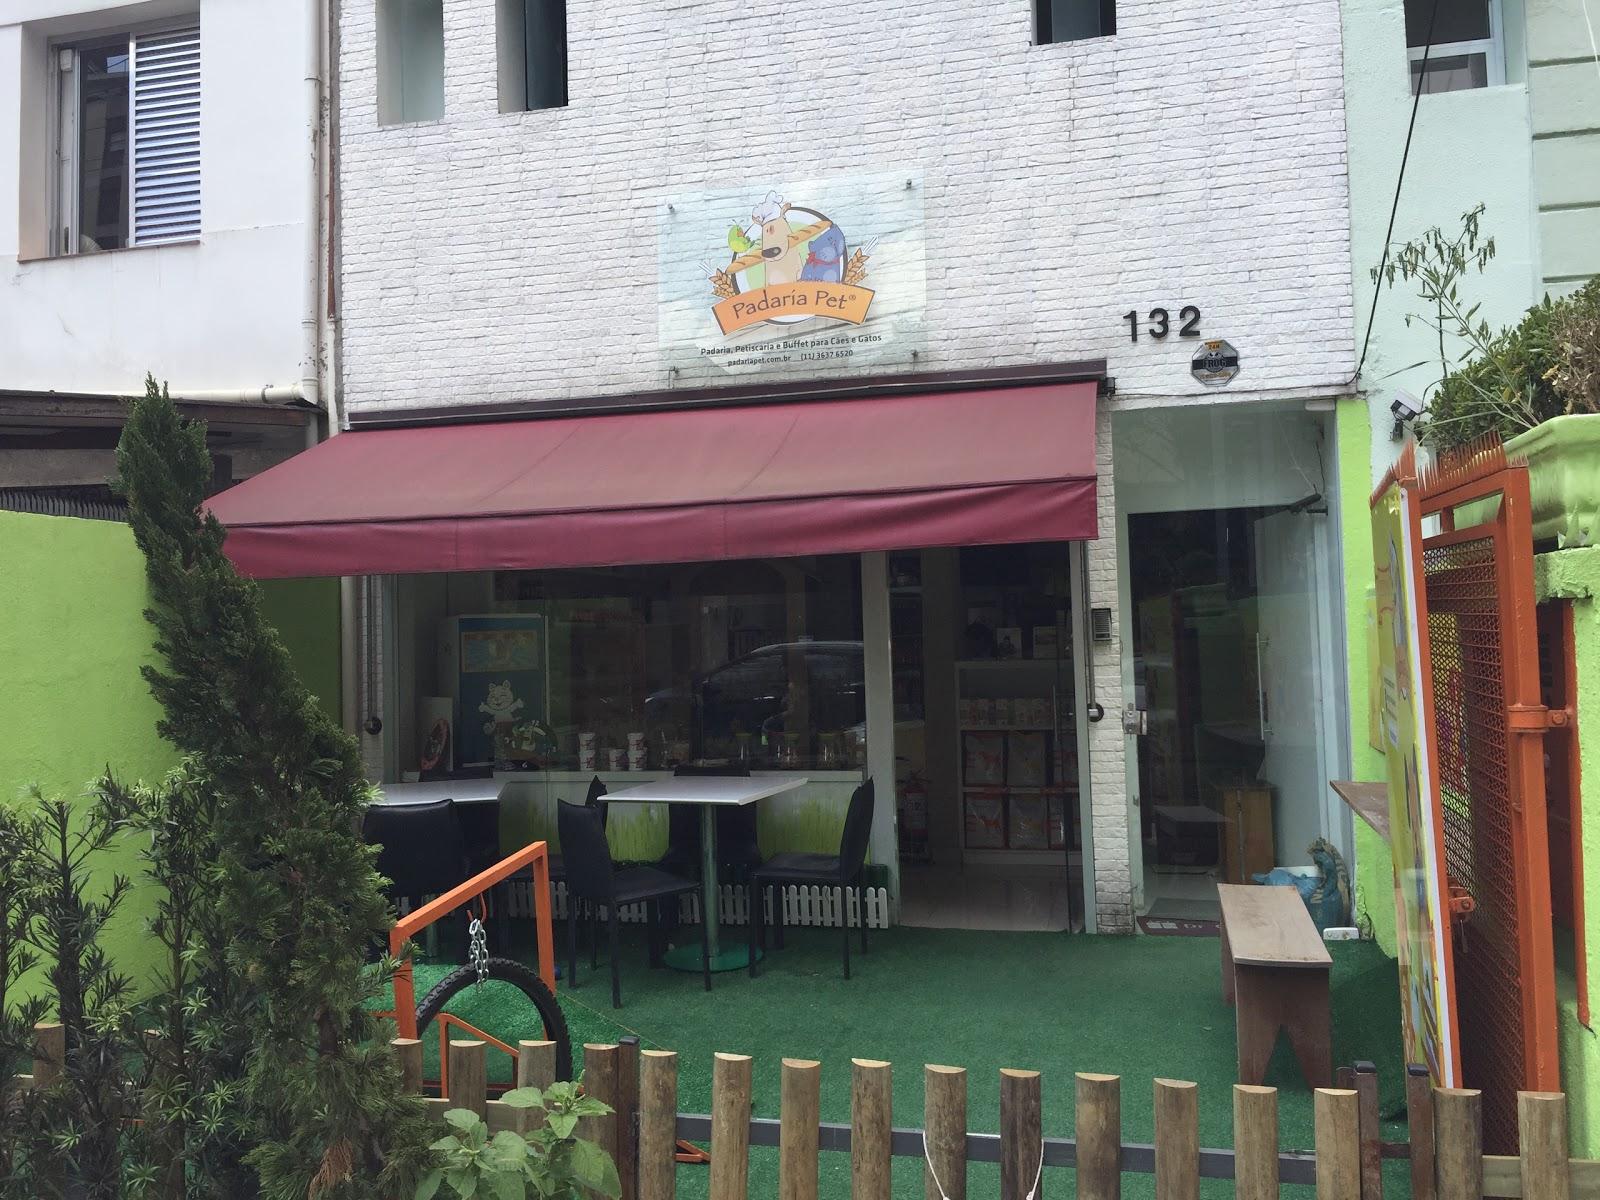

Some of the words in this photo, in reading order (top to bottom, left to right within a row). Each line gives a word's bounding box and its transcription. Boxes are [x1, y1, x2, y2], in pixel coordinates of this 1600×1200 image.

[733, 289, 807, 320] Padaría
[1123, 305, 1201, 342] 132
[701, 347, 733, 356] Padaria,
[735, 343, 774, 354] Petiscaria
[783, 340, 809, 350] Buffet
[811, 339, 829, 349] para
[830, 336, 850, 346] Cães
[858, 334, 882, 343] Gatos
[727, 355, 791, 367] padariapet.com.br
[800, 352, 815, 361] (11)
[817, 351, 834, 360] 3637
[835, 349, 853, 359] 6520
[1203, 358, 1227, 369] FROG
